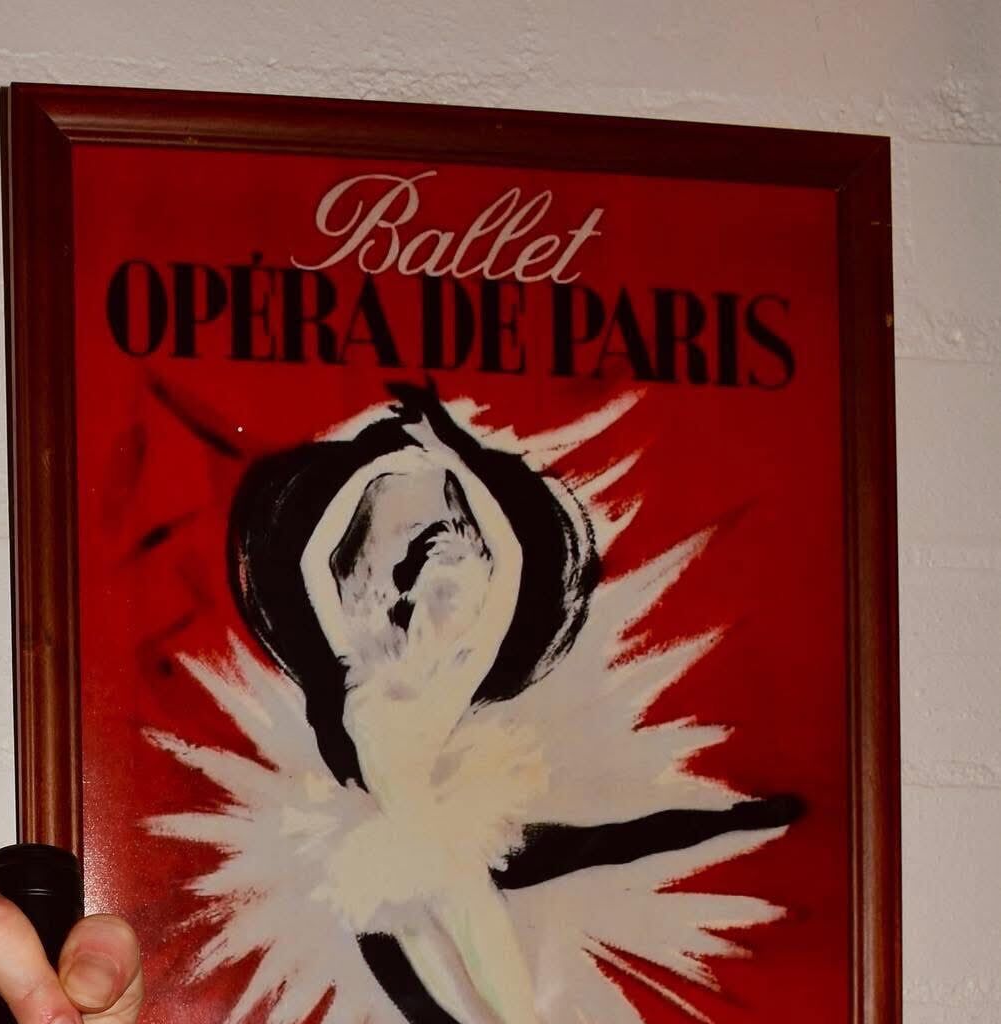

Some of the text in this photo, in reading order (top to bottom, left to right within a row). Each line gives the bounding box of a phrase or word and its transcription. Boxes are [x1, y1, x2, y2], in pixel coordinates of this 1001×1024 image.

[289, 170, 605, 284] Ballet
[105, 252, 798, 390] OPÉRA DE PARIS
